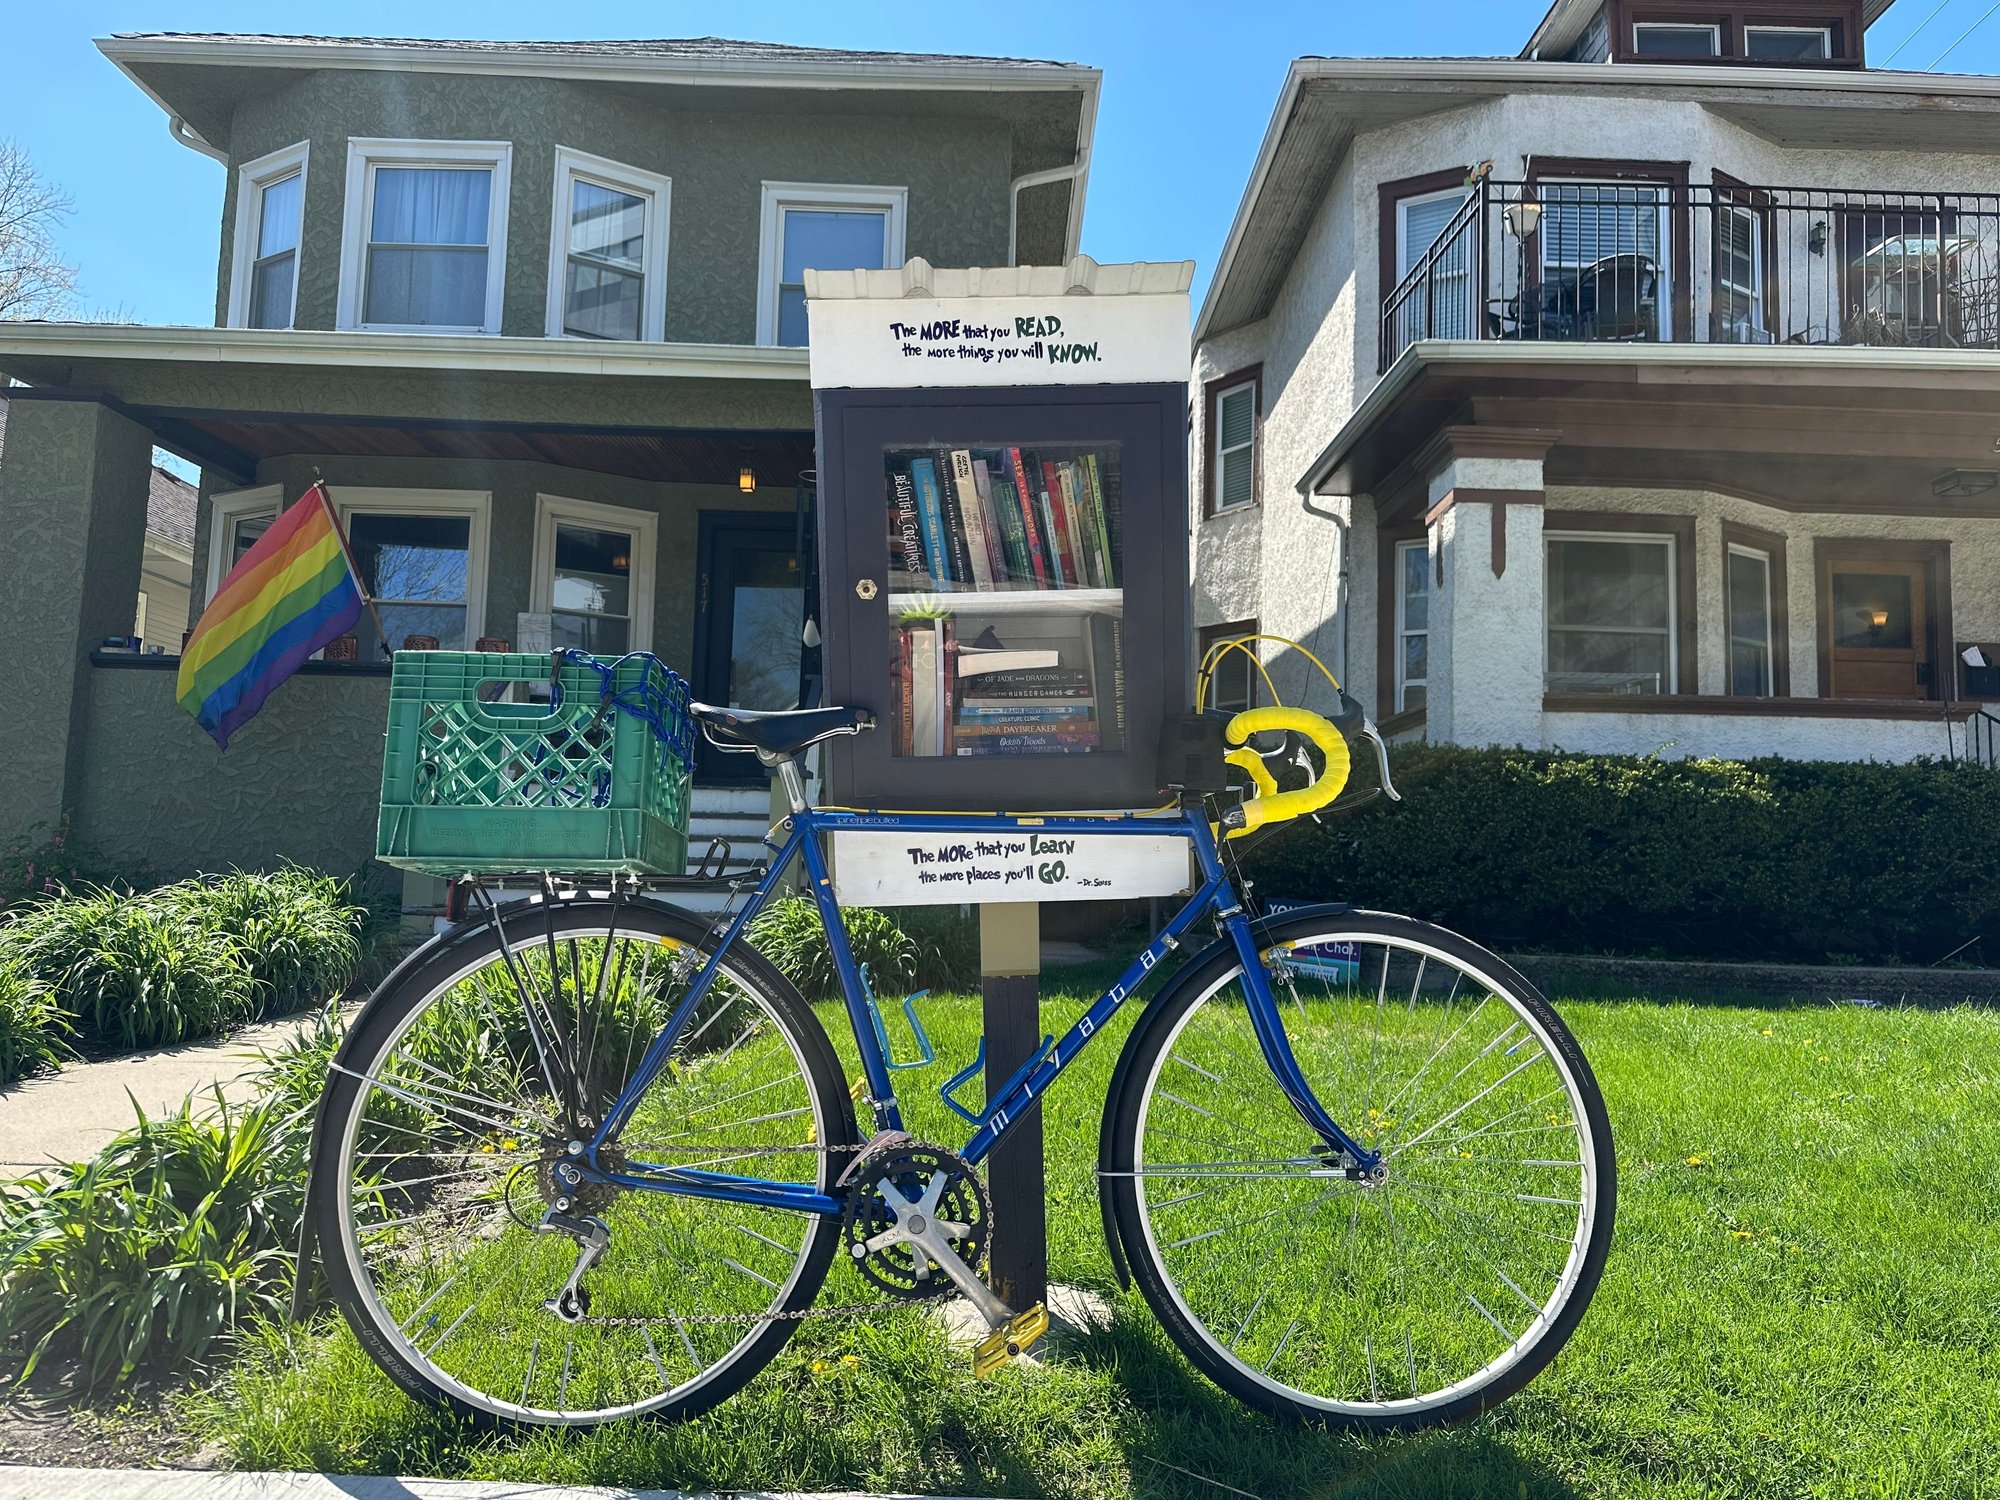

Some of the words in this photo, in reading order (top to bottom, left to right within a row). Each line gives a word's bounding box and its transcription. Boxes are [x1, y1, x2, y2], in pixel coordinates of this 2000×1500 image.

[890, 322, 917, 341] The
[920, 319, 960, 341] MORE
[963, 324, 988, 339] that
[990, 326, 1010, 342] you
[1015, 315, 1064, 338] READ,
[902, 343, 922, 357] the
[957, 344, 994, 362] things
[998, 347, 1018, 363] you
[1021, 341, 1043, 359] will
[1047, 342, 1102, 364] KNOW.
[893, 472, 916, 526] BEAUTIFUL
[1013, 459, 1023, 478] SEX
[1025, 512, 1036, 538] WORD
[927, 516, 940, 548] SCARLETT
[964, 507, 976, 546] MOUNTAIN
[900, 518, 923, 575] CREATURES
[1114, 670, 1125, 697] MARK
[1003, 724, 1057, 733] DAYBREAKER
[1116, 700, 1126, 729] TWAIN
[907, 848, 935, 865] The
[974, 840, 1002, 857] that
[1002, 842, 1025, 859] you
[1029, 834, 1075, 856] Learn
[919, 869, 937, 884] the
[966, 866, 1001, 884] places
[1004, 865, 1034, 883] you'll
[1038, 860, 1069, 884] GO.
[1093, 878, 1112, 887] Seuss
[1527, 998, 1578, 1059] PIRELLI
[363, 1329, 421, 1389] PIRELLI
